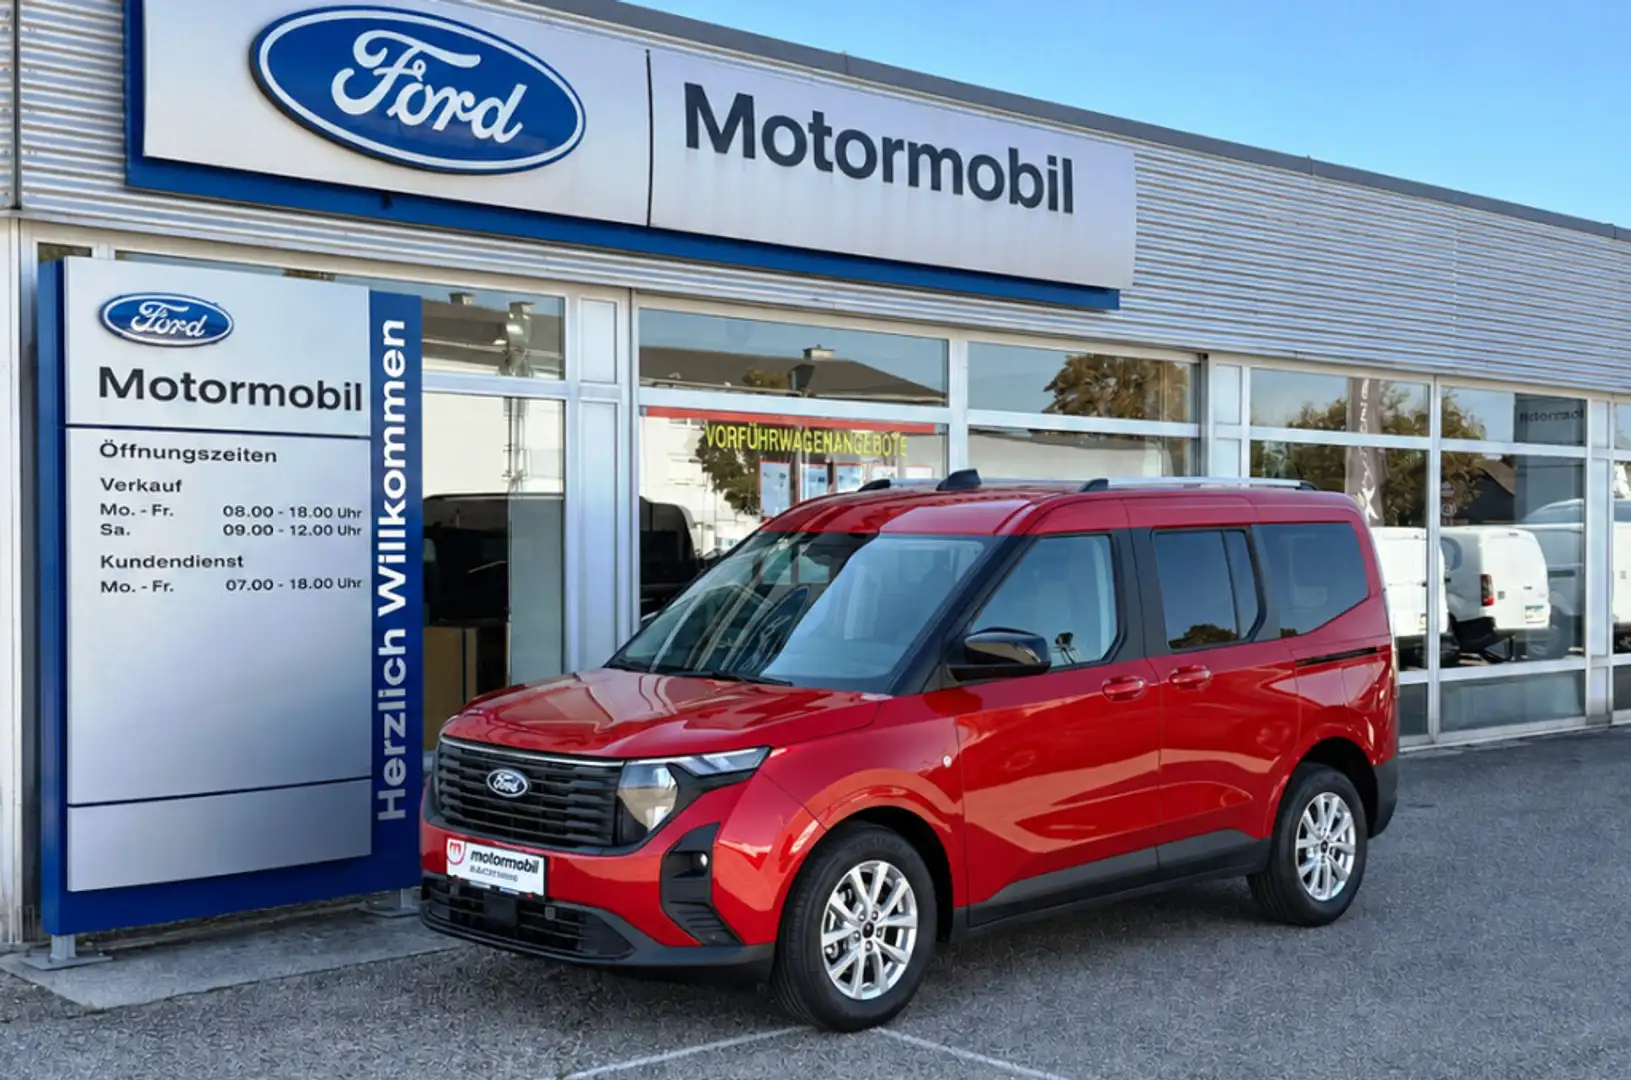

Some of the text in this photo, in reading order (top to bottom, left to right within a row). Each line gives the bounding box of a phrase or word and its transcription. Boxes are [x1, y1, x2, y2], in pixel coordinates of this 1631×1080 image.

[331, 30, 528, 144] Ford
[684, 82, 1074, 215] Motormobil
[130, 301, 208, 337] Ford
[99, 366, 362, 412] Motormobil
[99, 439, 277, 464] Öffnungszeiten
[99, 477, 183, 493] Verkauf
[99, 502, 136, 517] Mo.
[151, 503, 175, 518] Fr.
[222, 504, 274, 519] 08.00
[289, 505, 334, 520] 18.00
[337, 506, 363, 519] Uhr
[99, 522, 131, 537] Sa.
[222, 523, 274, 537] 09.00
[289, 523, 334, 537] 12.00
[337, 524, 363, 537] Uhr
[100, 554, 244, 570] Kundendienst
[377, 319, 407, 820] Herzlich Willkommen
[100, 580, 136, 594] Mo.
[152, 580, 175, 594] Fr.
[225, 578, 274, 592] 07.00
[290, 577, 334, 592] 18.00
[337, 577, 363, 590] Uhr
[470, 850, 540, 874] motormobil
